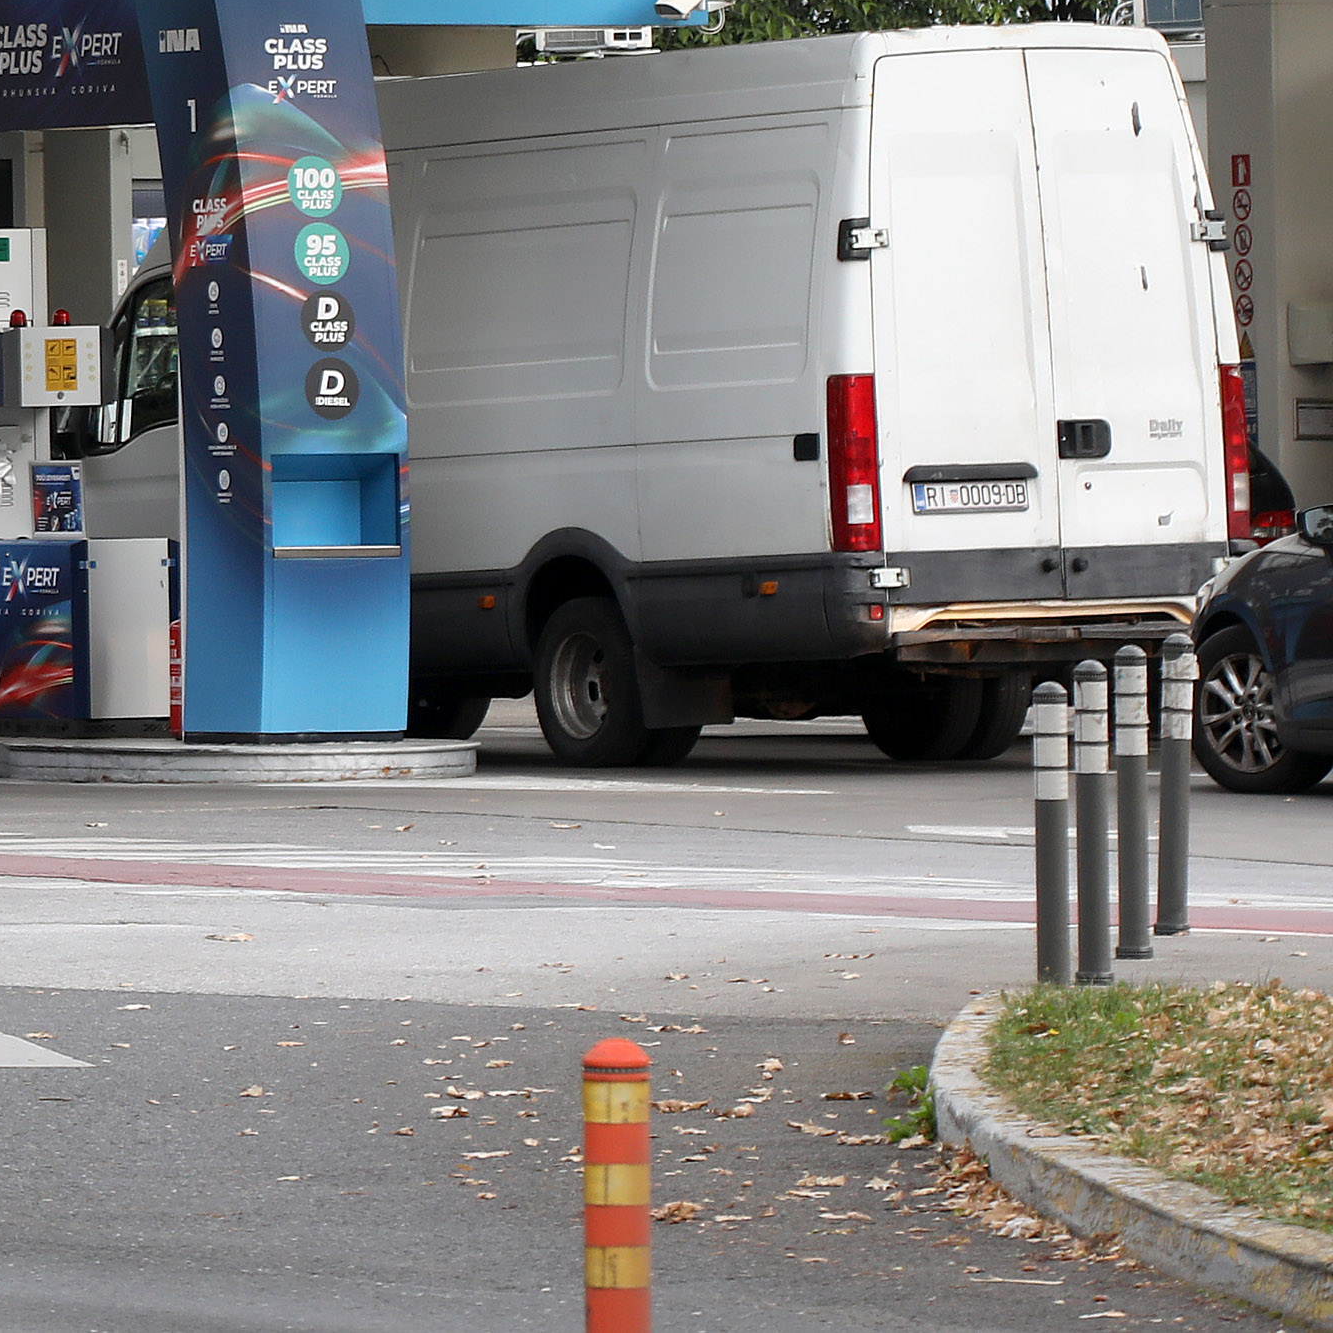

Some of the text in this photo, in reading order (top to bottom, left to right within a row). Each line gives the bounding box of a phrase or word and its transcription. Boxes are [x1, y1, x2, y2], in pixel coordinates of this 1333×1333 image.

[264, 38, 328, 54] CLASS
[273, 54, 324, 70] PLUS
[187, 99, 197, 133] 1
[293, 168, 336, 189] 100
[297, 190, 334, 200] CLASS
[193, 197, 228, 214] CLASS
[302, 200, 332, 210] PLUS
[306, 234, 337, 256] 95
[304, 256, 342, 266] CLASS
[308, 267, 339, 277] PLUS
[317, 297, 340, 320] D
[310, 321, 348, 332] CLASS
[314, 332, 345, 343] PLUS
[319, 369, 345, 396] D
[318, 397, 350, 406] DIESEL
[926, 486, 946, 507] RI
